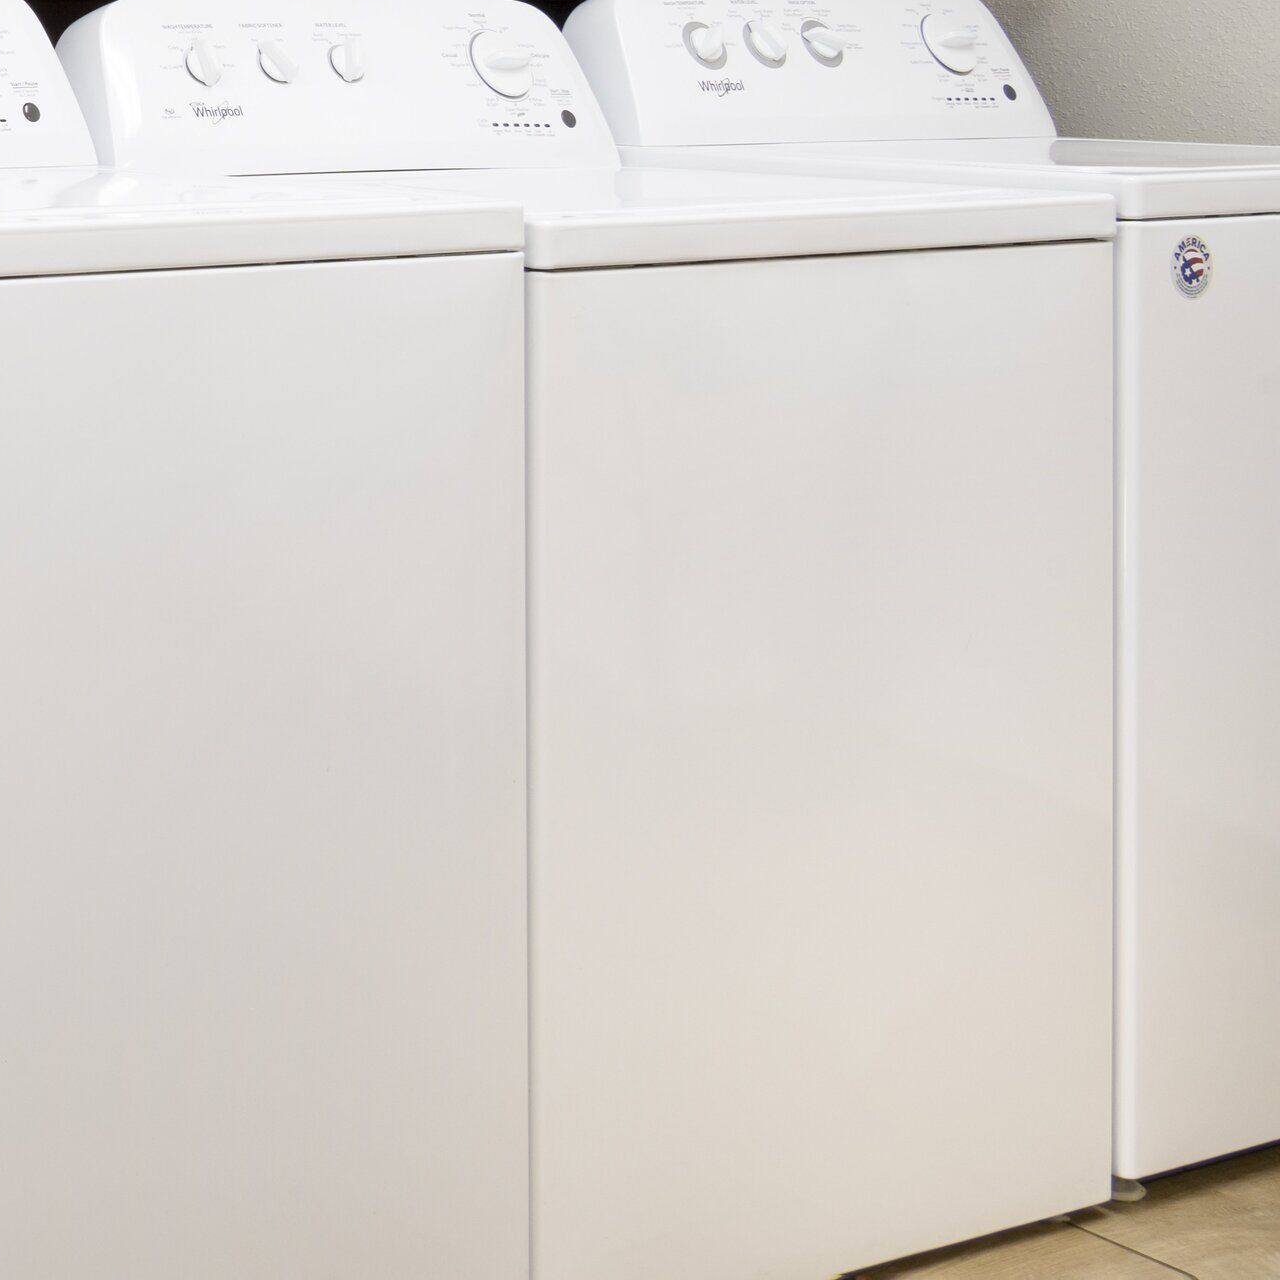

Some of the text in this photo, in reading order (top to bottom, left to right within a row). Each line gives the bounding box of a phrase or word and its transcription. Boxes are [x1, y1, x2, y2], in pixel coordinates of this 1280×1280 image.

[697, 79, 745, 95] Whirlpool
[192, 104, 244, 121] Whirlpool
[1175, 237, 1209, 261] AMERICA
